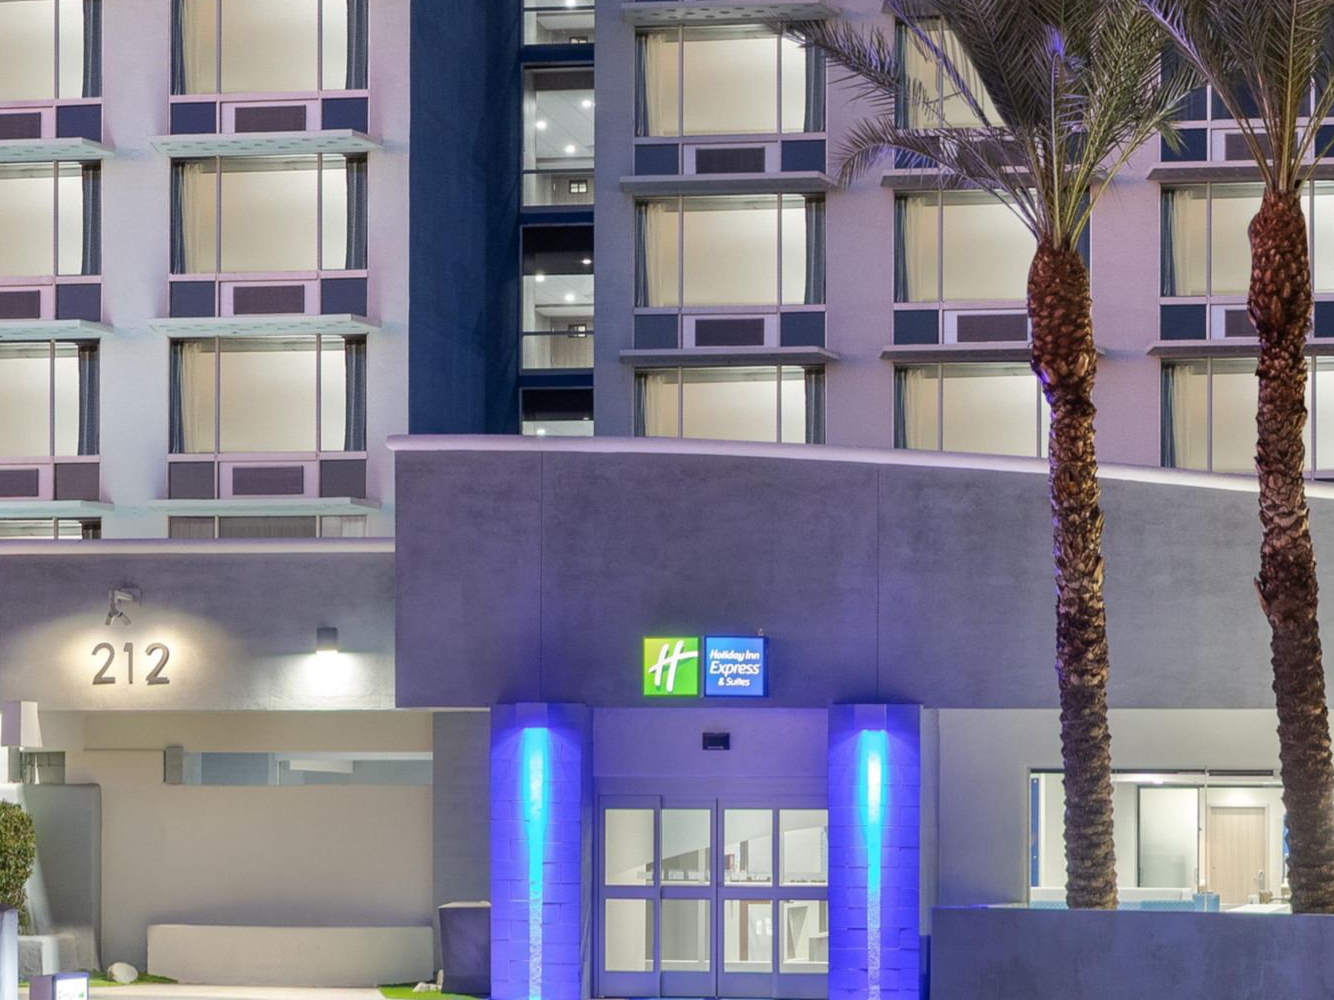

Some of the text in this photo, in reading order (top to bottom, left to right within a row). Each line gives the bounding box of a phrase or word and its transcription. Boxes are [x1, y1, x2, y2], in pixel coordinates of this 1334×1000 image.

[91, 642, 170, 685] 212
[710, 649, 760, 662] Holiday Inn
[648, 640, 699, 692] H
[709, 660, 760, 677] Express
[718, 677, 750, 686] & Suites
